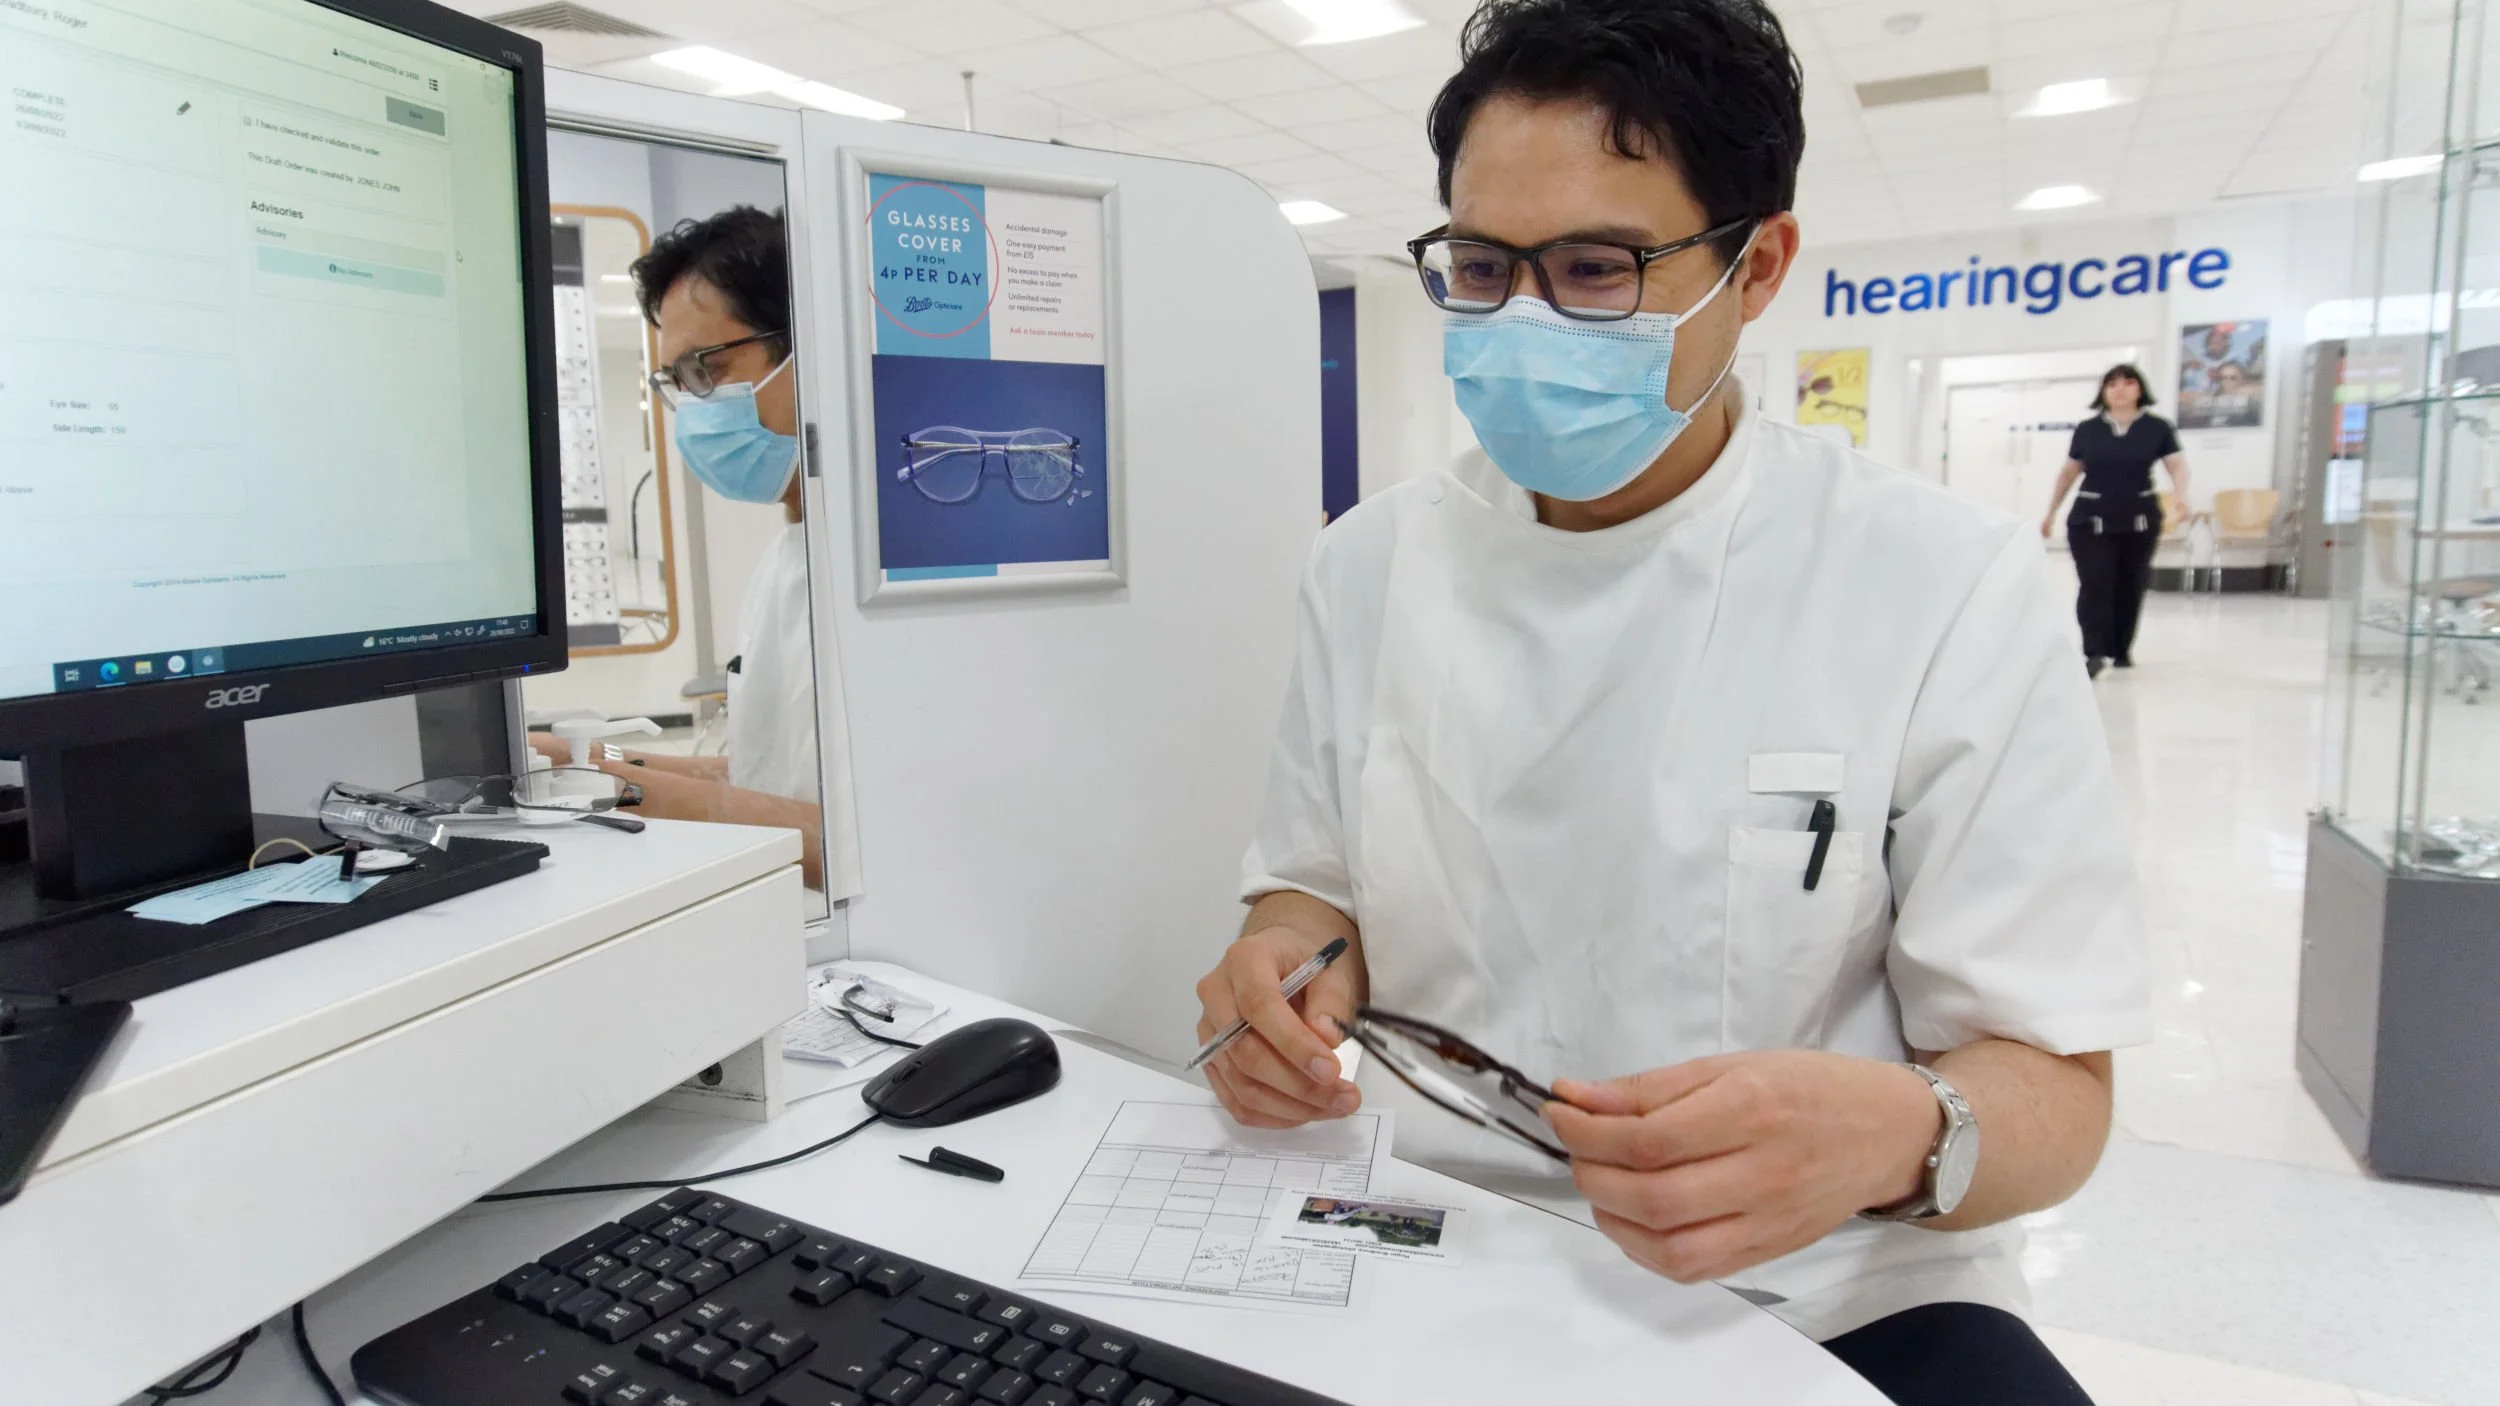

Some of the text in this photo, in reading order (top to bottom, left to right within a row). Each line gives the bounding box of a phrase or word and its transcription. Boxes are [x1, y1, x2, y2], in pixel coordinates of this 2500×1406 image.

[260, 119, 278, 132] have
[280, 126, 309, 139] checked
[310, 132, 324, 142] and
[325, 137, 349, 149] validate
[248, 151, 264, 162] This
[284, 160, 303, 171] Order
[305, 166, 318, 175] was
[320, 169, 345, 181] created
[250, 200, 304, 219] Advisories
[887, 210, 971, 232] GLASSES
[1005, 223, 1068, 238] Accidental damage
[898, 233, 962, 253] COVER
[1006, 239, 1066, 252] One easy payment
[916, 254, 946, 265] FROM
[1006, 249, 1022, 258] from
[904, 267, 938, 283] PER
[947, 271, 982, 286] DAY
[1019, 268, 1039, 276] excess
[1048, 271, 1060, 279] pay
[1008, 278, 1020, 286] you
[1020, 278, 1038, 286] make
[1045, 280, 1062, 288] claim
[1824, 246, 2231, 317] hearingcare
[903, 296, 933, 313] Boots
[1008, 293, 1061, 304] Unlimited repairs
[1017, 304, 1059, 314] replacements
[1075, 331, 1095, 339] today
[396, 634, 418, 644] Mostly
[418, 632, 439, 642] cloudy
[204, 683, 271, 709] acer
